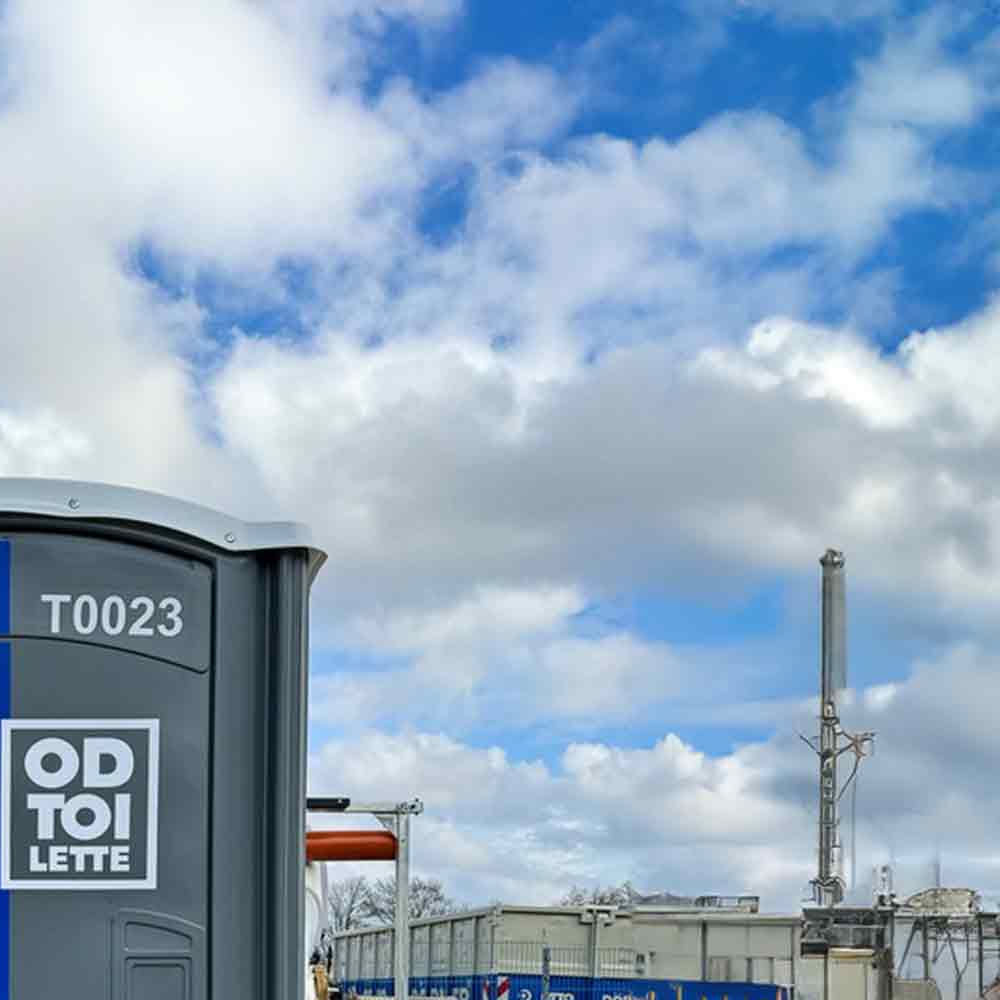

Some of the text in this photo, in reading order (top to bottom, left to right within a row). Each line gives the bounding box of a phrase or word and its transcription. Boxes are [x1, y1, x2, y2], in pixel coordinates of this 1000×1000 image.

[40, 594, 184, 637] T0023
[23, 737, 135, 789] OD
[26, 793, 132, 841] TOI
[29, 845, 131, 873] LETTE
